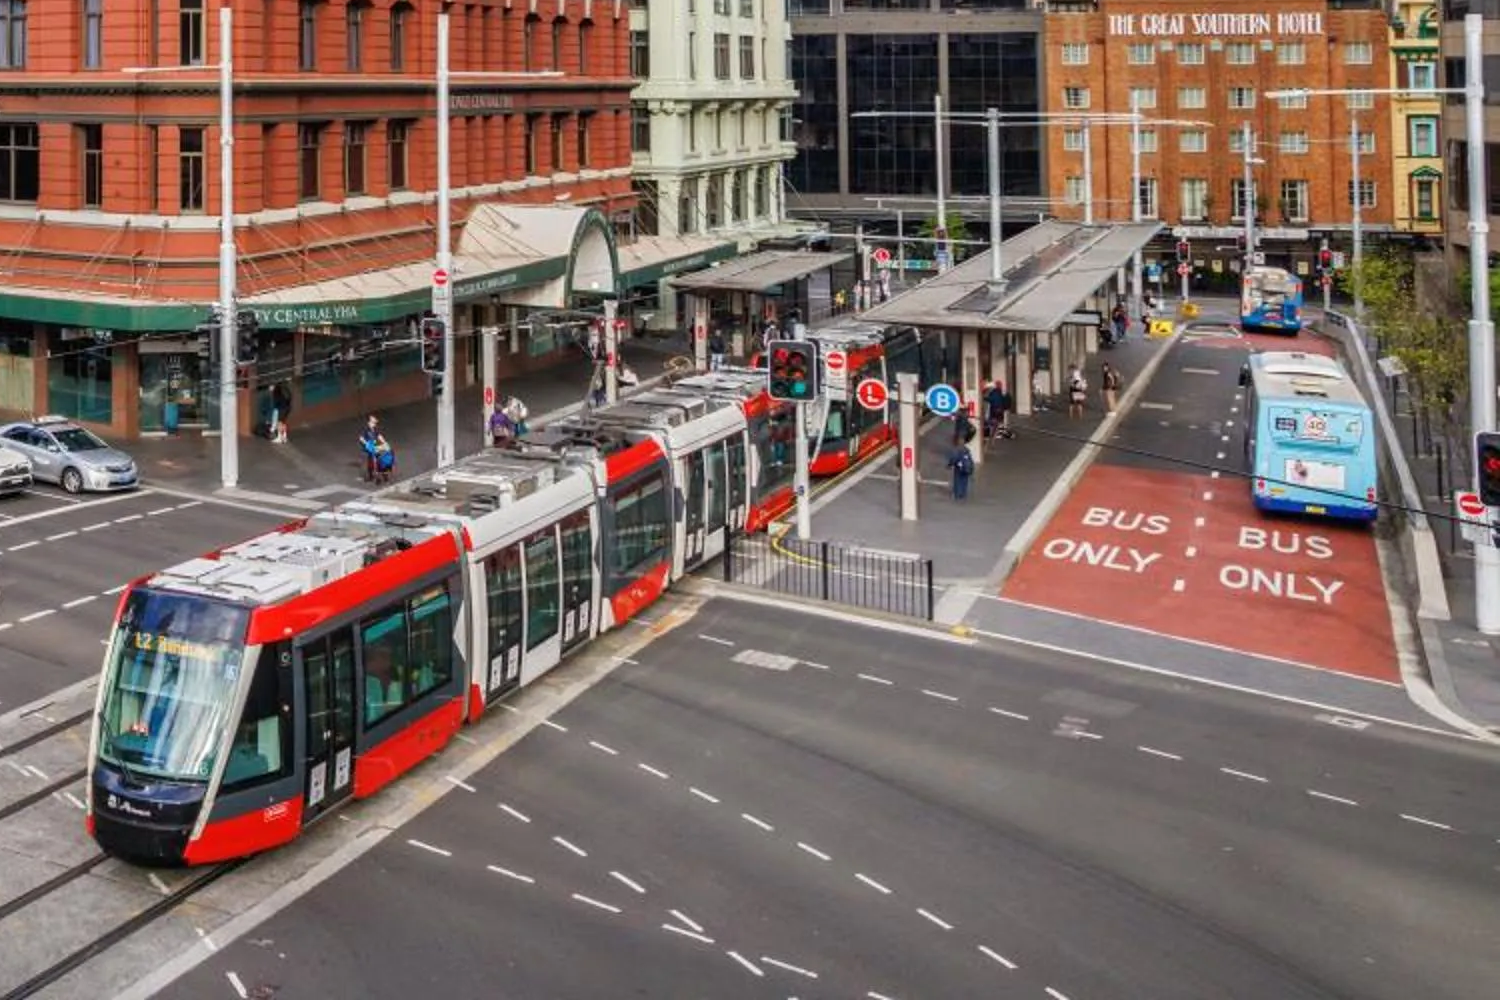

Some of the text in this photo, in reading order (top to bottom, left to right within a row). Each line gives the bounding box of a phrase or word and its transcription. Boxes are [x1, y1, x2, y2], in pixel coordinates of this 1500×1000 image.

[1108, 12, 1325, 35] THE GREAT SOUTHERN HOTEL
[273, 307, 333, 323] CENTRAL
[333, 305, 358, 318] YHA
[867, 384, 880, 402] L
[936, 391, 951, 409] B
[1082, 506, 1170, 534] BUS
[1238, 526, 1333, 559] BUS
[1043, 538, 1162, 574] ONLY
[1219, 565, 1344, 604] ONLY
